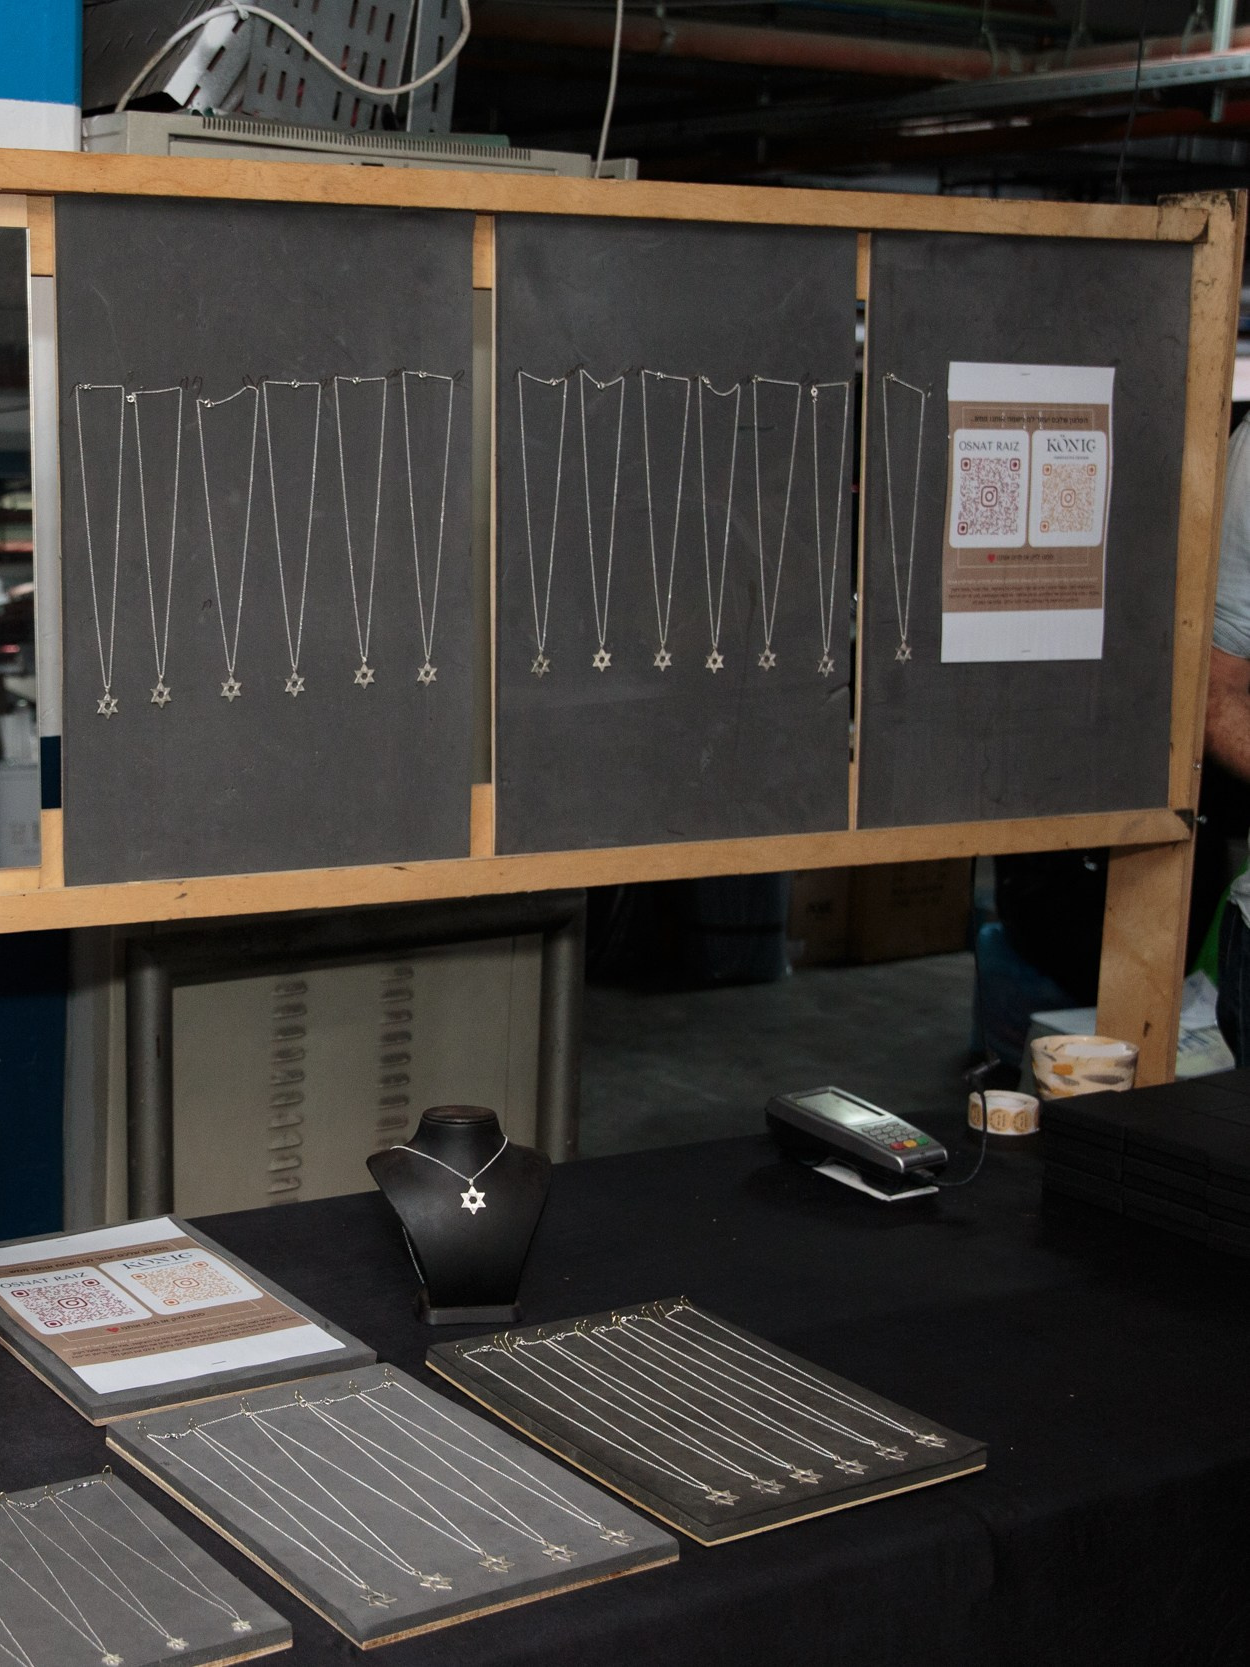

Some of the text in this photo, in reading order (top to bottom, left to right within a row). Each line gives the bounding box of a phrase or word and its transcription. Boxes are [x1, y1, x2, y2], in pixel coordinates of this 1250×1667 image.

[958, 440, 1020, 452] OSNAT RAIZ
[1046, 434, 1096, 454] KÖNIG
[122, 1251, 193, 1270] KÖNIG
[0, 1271, 89, 1290] OSNAT RAIZ
